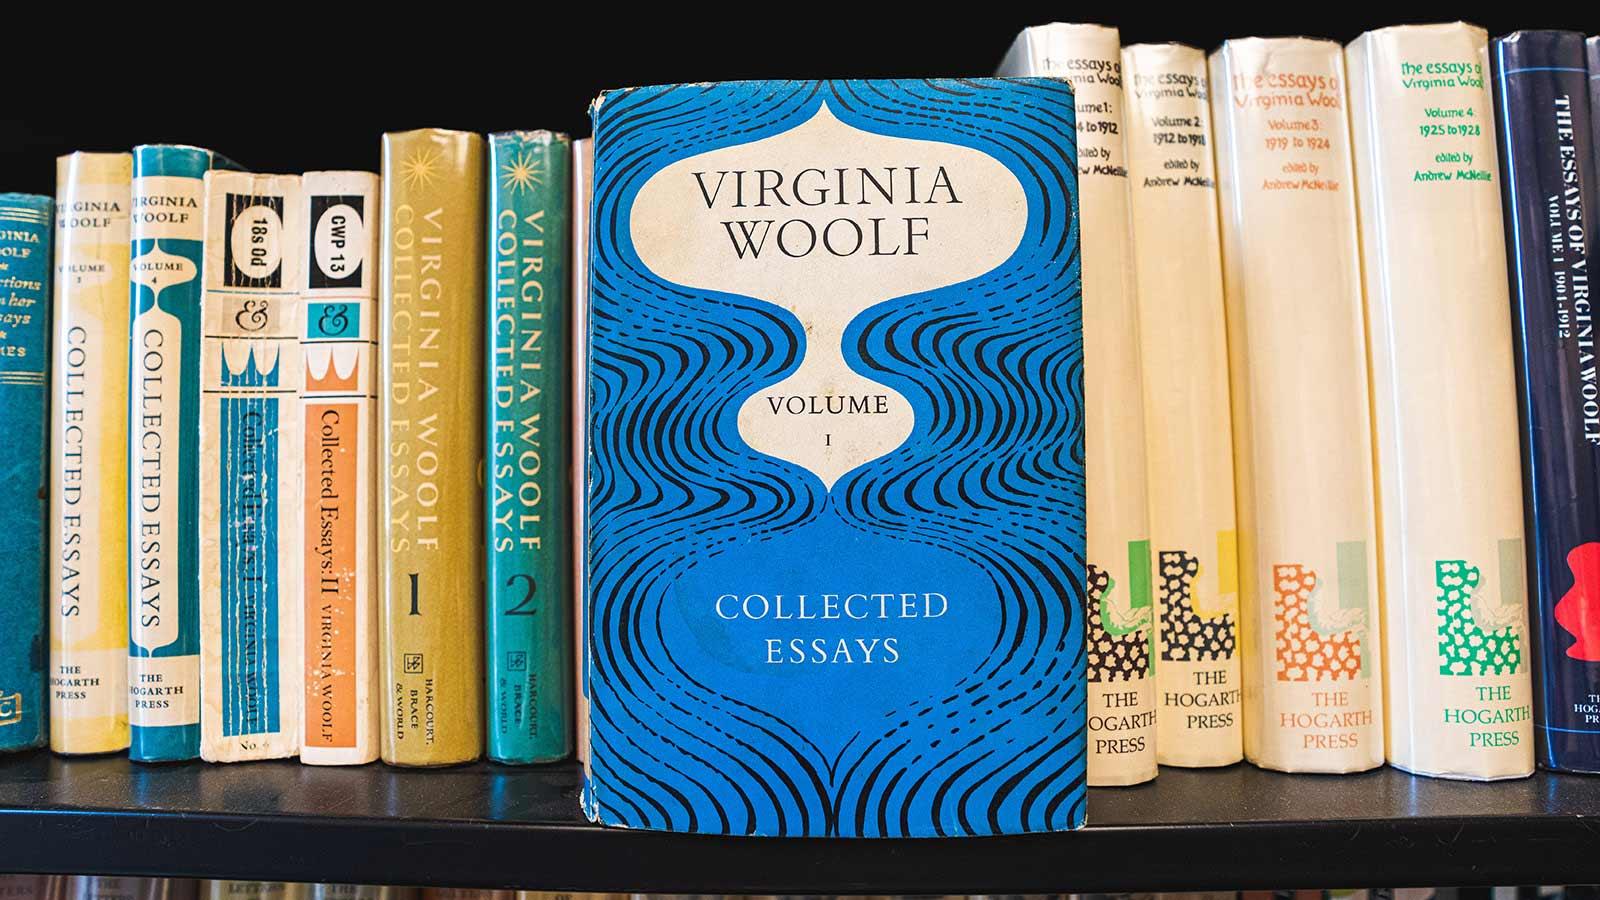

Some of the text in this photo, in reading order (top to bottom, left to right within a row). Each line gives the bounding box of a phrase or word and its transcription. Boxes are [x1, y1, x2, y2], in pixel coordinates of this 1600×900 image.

[1067, 59, 1112, 73] essays
[1426, 62, 1473, 76] essays
[1267, 74, 1327, 91] essays
[1402, 78, 1455, 91] Virginia
[1077, 104, 1103, 113] ume
[1424, 107, 1464, 118] Volume
[1086, 121, 1097, 132] to
[1098, 120, 1119, 134] 1912
[1152, 116, 1192, 127] Volume
[1268, 119, 1310, 131] Volume
[1419, 124, 1480, 137] 1925 to 1928
[1153, 133, 1176, 146] 1912
[1177, 133, 1187, 143] to
[1265, 136, 1331, 151] 1919 to 1924
[1078, 147, 1111, 161] dited by
[1435, 152, 1473, 166] edited by
[1164, 160, 1200, 172] edited by
[1282, 162, 1319, 176] edited by
[1144, 177, 1181, 188] Andrew
[1262, 178, 1300, 190] Andrew
[1414, 170, 1452, 182] Andrew
[691, 165, 963, 209] VIRGINIA
[251, 217, 269, 244] 18s
[1549, 195, 1564, 253] VOLUME
[330, 215, 346, 272] CWP 13
[720, 217, 931, 260] WOOLF
[0, 247, 31, 258] OLF
[1555, 95, 1600, 446] THE ESSAYS OF VIRGINIA WOOLF
[0, 276, 41, 290] tions
[0, 346, 27, 357] ES
[390, 204, 415, 553] COLLECTED ESSAYS
[415, 207, 443, 551] VIRGINIA WOOLF
[494, 209, 518, 552] COLLECTED ESSAYS
[518, 210, 545, 551] VIRGINIA WOOLF
[767, 395, 889, 415] VOLUME
[825, 433, 832, 447] I
[321, 409, 340, 499] Collected
[61, 326, 87, 617] COLLECTED ESSAYS
[140, 329, 164, 628] COLLECTED ESSAYS
[321, 576, 339, 594] II
[408, 572, 422, 617] 1
[503, 573, 537, 617] 2
[715, 592, 949, 620] COLLECTED
[321, 604, 333, 680] VIRGINIA
[764, 637, 900, 664] ESSAYS
[60, 666, 81, 674] THE
[139, 674, 163, 683] THE
[1193, 670, 1228, 686] THE
[56, 691, 87, 699] PRESS
[1103, 691, 1139, 708] THE
[1312, 691, 1349, 707] THE
[1475, 685, 1511, 701] THE
[135, 700, 170, 708] PRESS
[410, 690, 419, 729] BRACE
[514, 684, 523, 723] BRACE
[321, 684, 333, 742] WOOLF
[396, 696, 405, 740] WORLD
[500, 691, 508, 734] WORLD
[1088, 708, 1157, 732] OGARTH
[1187, 712, 1234, 729] PRESS
[1280, 709, 1373, 729] HOGARTH
[1444, 704, 1531, 724] HOGARTH
[1096, 736, 1146, 754] PRESS
[1303, 733, 1359, 749] PRESS
[1470, 730, 1520, 748] PRESS
